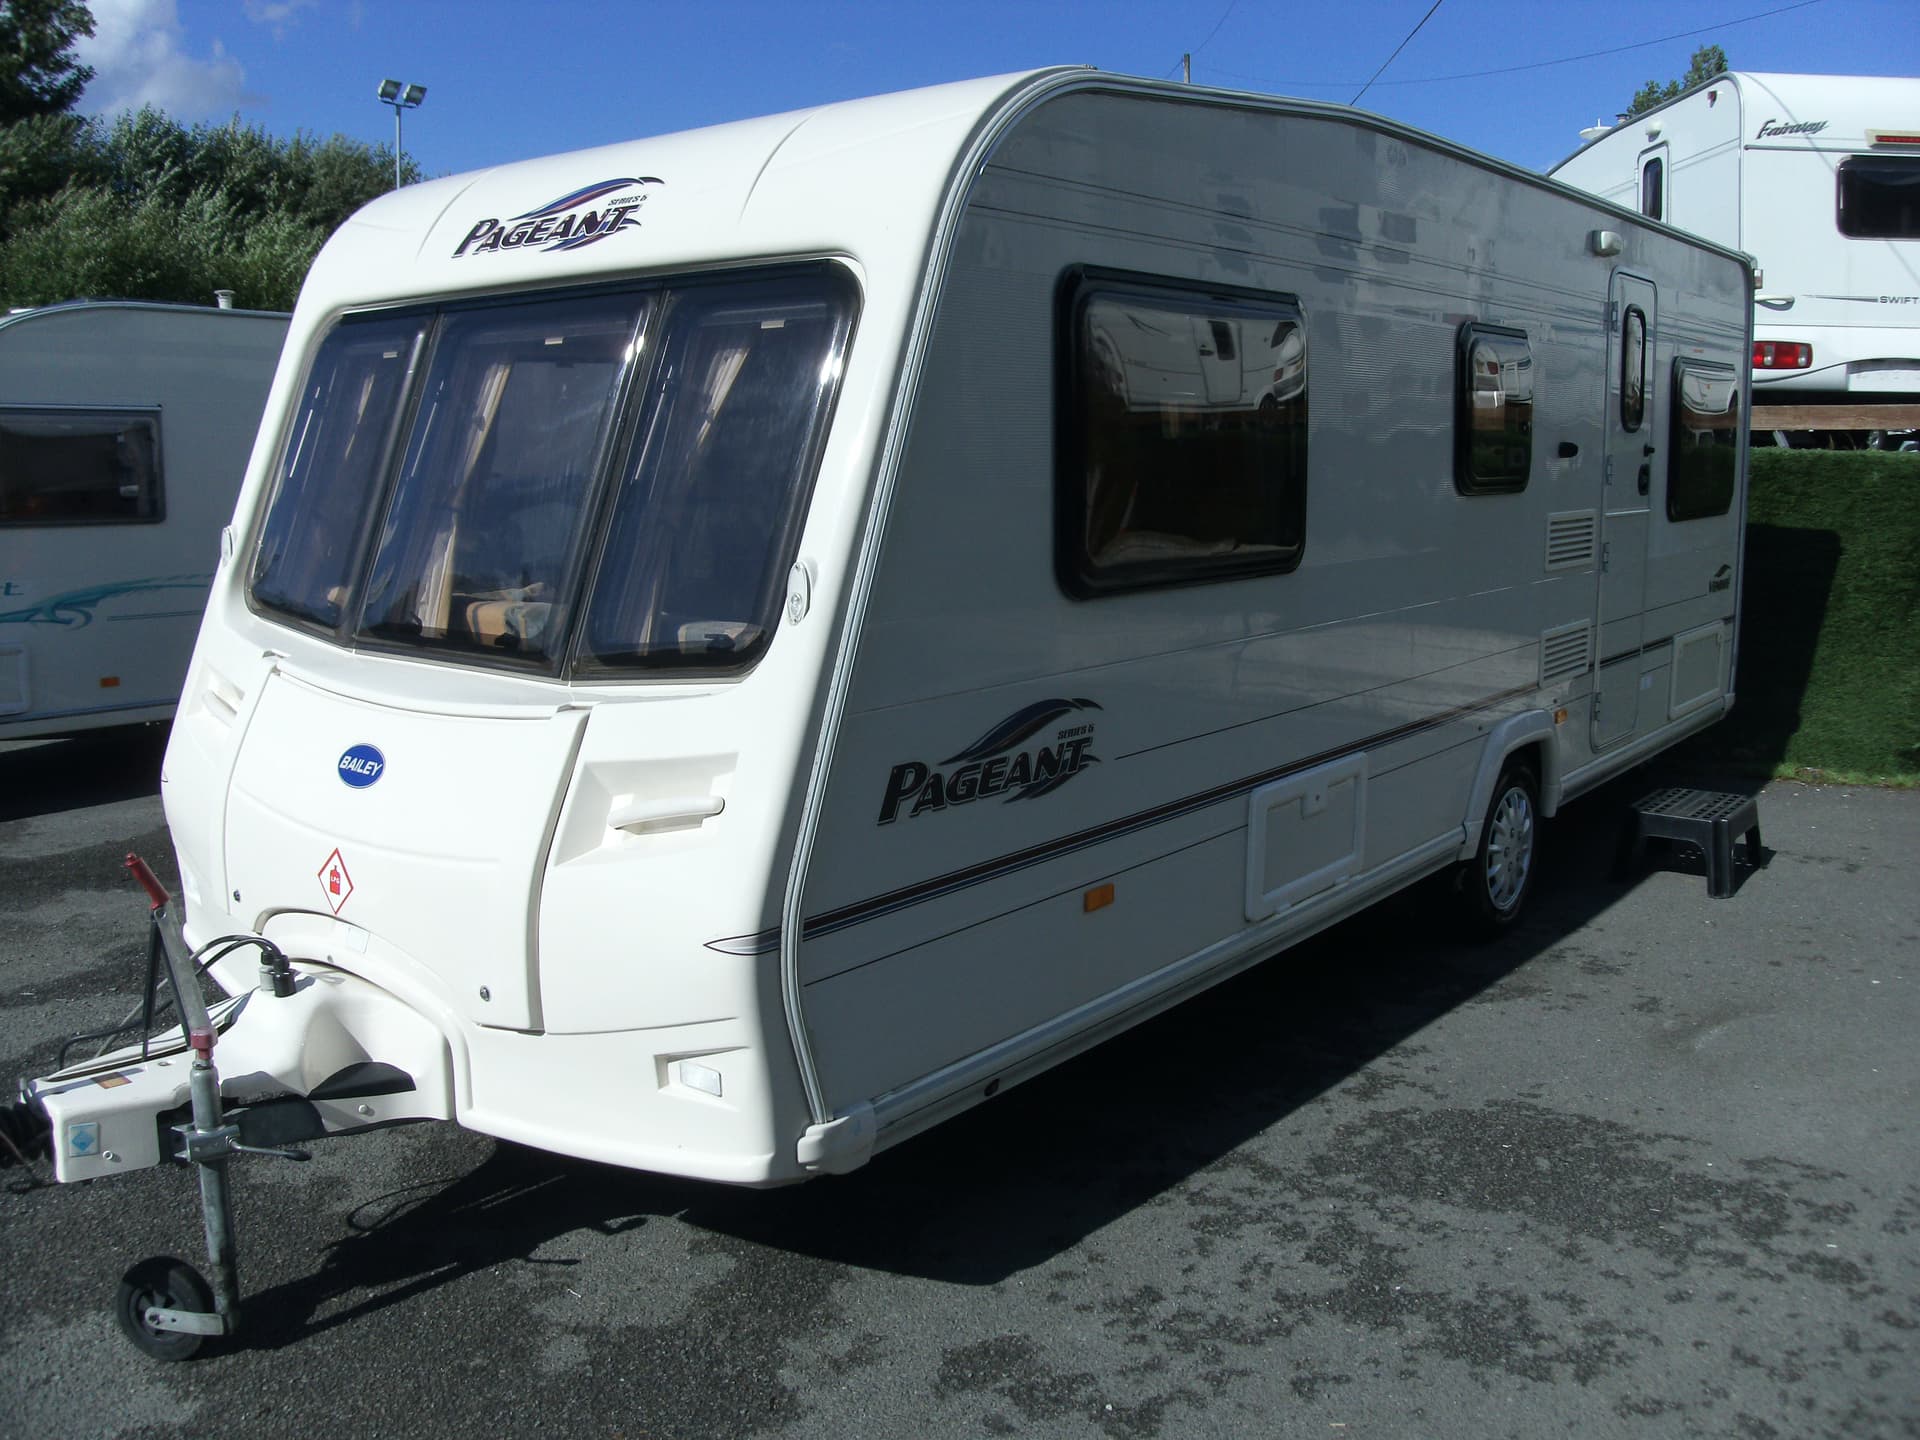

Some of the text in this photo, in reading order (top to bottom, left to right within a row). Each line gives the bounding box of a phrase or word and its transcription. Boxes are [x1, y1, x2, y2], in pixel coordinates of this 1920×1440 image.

[1756, 119, 1829, 139] Fairway
[451, 204, 640, 258] PAGEANT
[1880, 296, 1919, 304] SWIFT
[1057, 725, 1087, 740] SERIES
[339, 755, 383, 777] BAILEY
[877, 737, 1093, 826] PAGEANT
